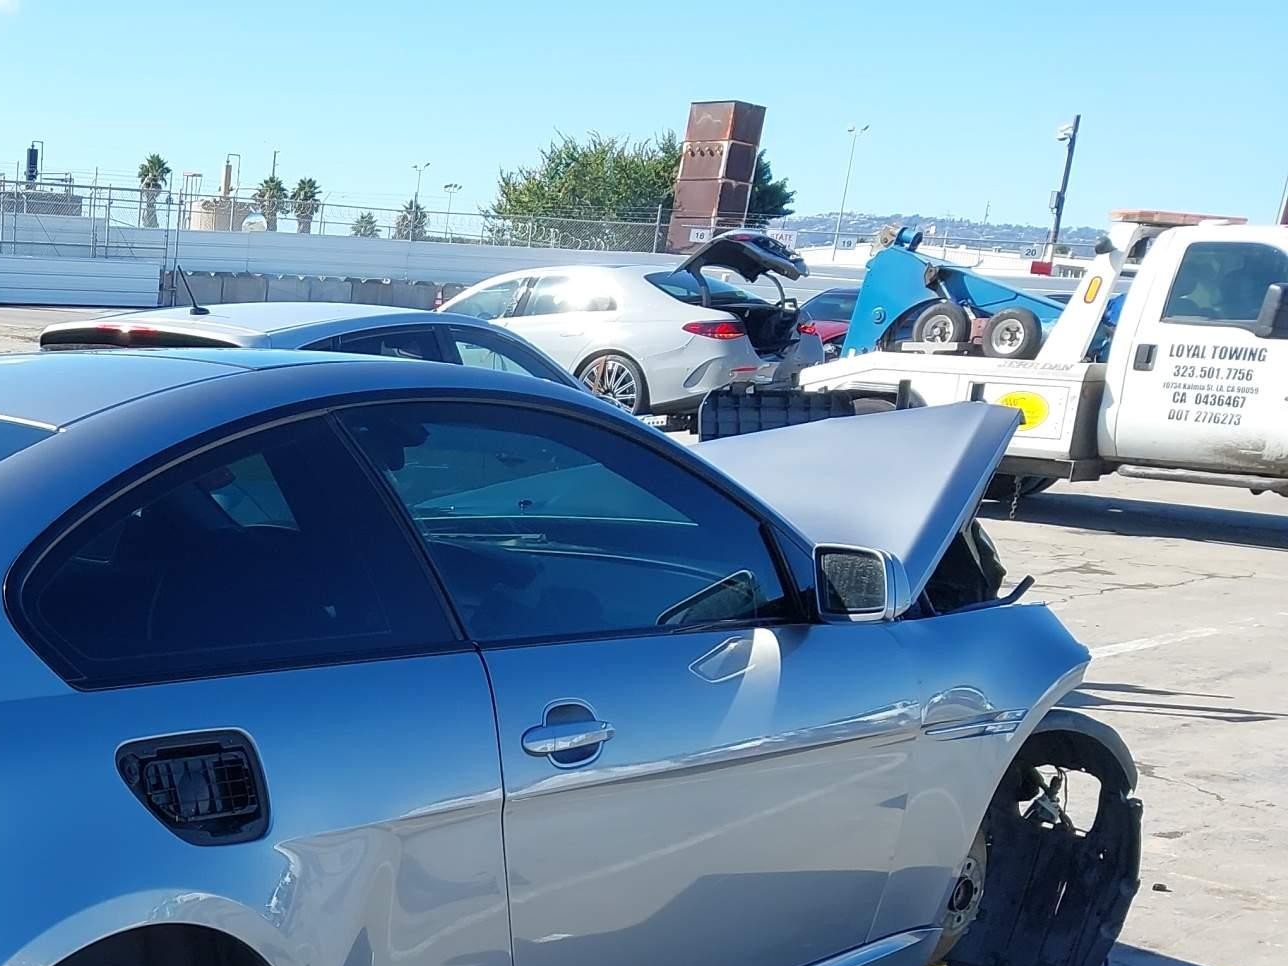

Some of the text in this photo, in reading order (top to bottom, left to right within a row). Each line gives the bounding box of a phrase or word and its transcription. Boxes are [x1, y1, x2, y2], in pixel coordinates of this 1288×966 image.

[1025, 248, 1037, 257] 20
[1169, 344, 1268, 362] LOYAL TOWING
[1173, 365, 1254, 381] 323.501.7756
[1172, 391, 1247, 408] CA 0436467
[1167, 408, 1242, 426] DOT 2776273
